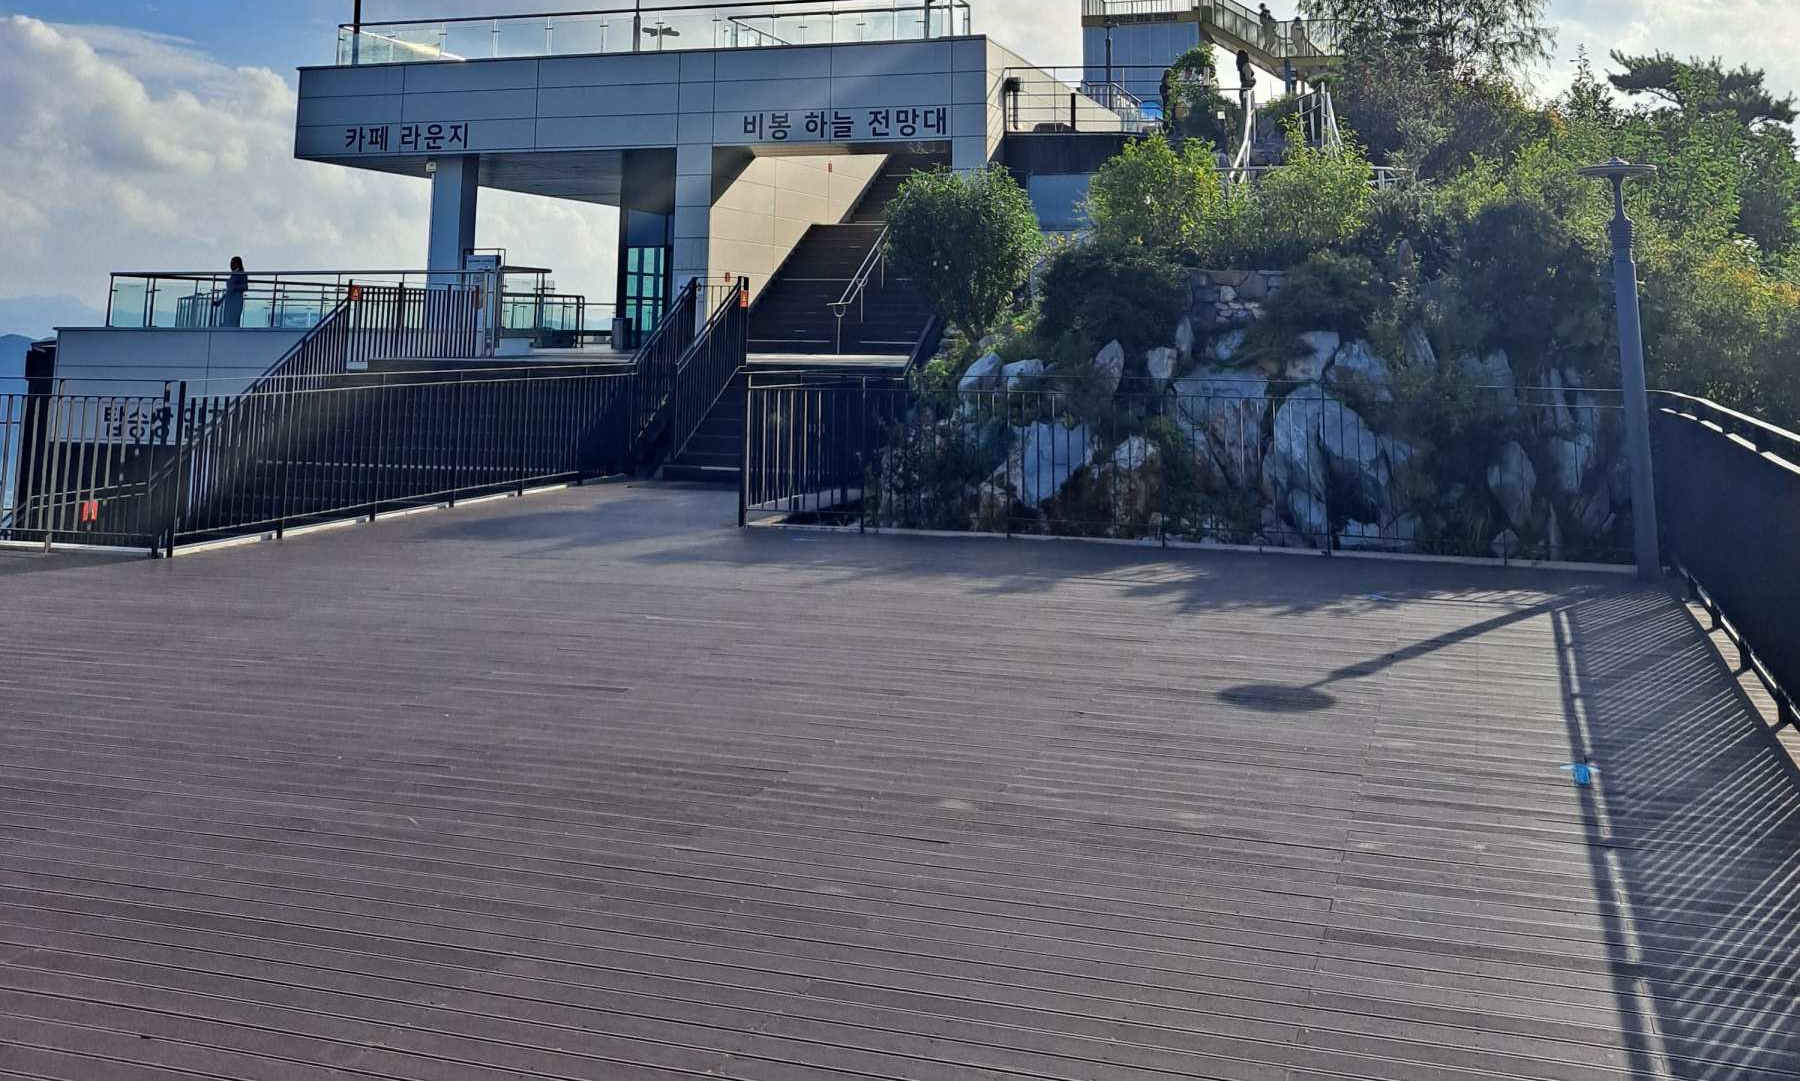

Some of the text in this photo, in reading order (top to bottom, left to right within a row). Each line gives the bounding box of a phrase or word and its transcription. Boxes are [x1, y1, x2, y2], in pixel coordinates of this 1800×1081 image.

[345, 122, 468, 152] 카페 라운지
[743, 107, 947, 141] 비봉 하늘 전망대
